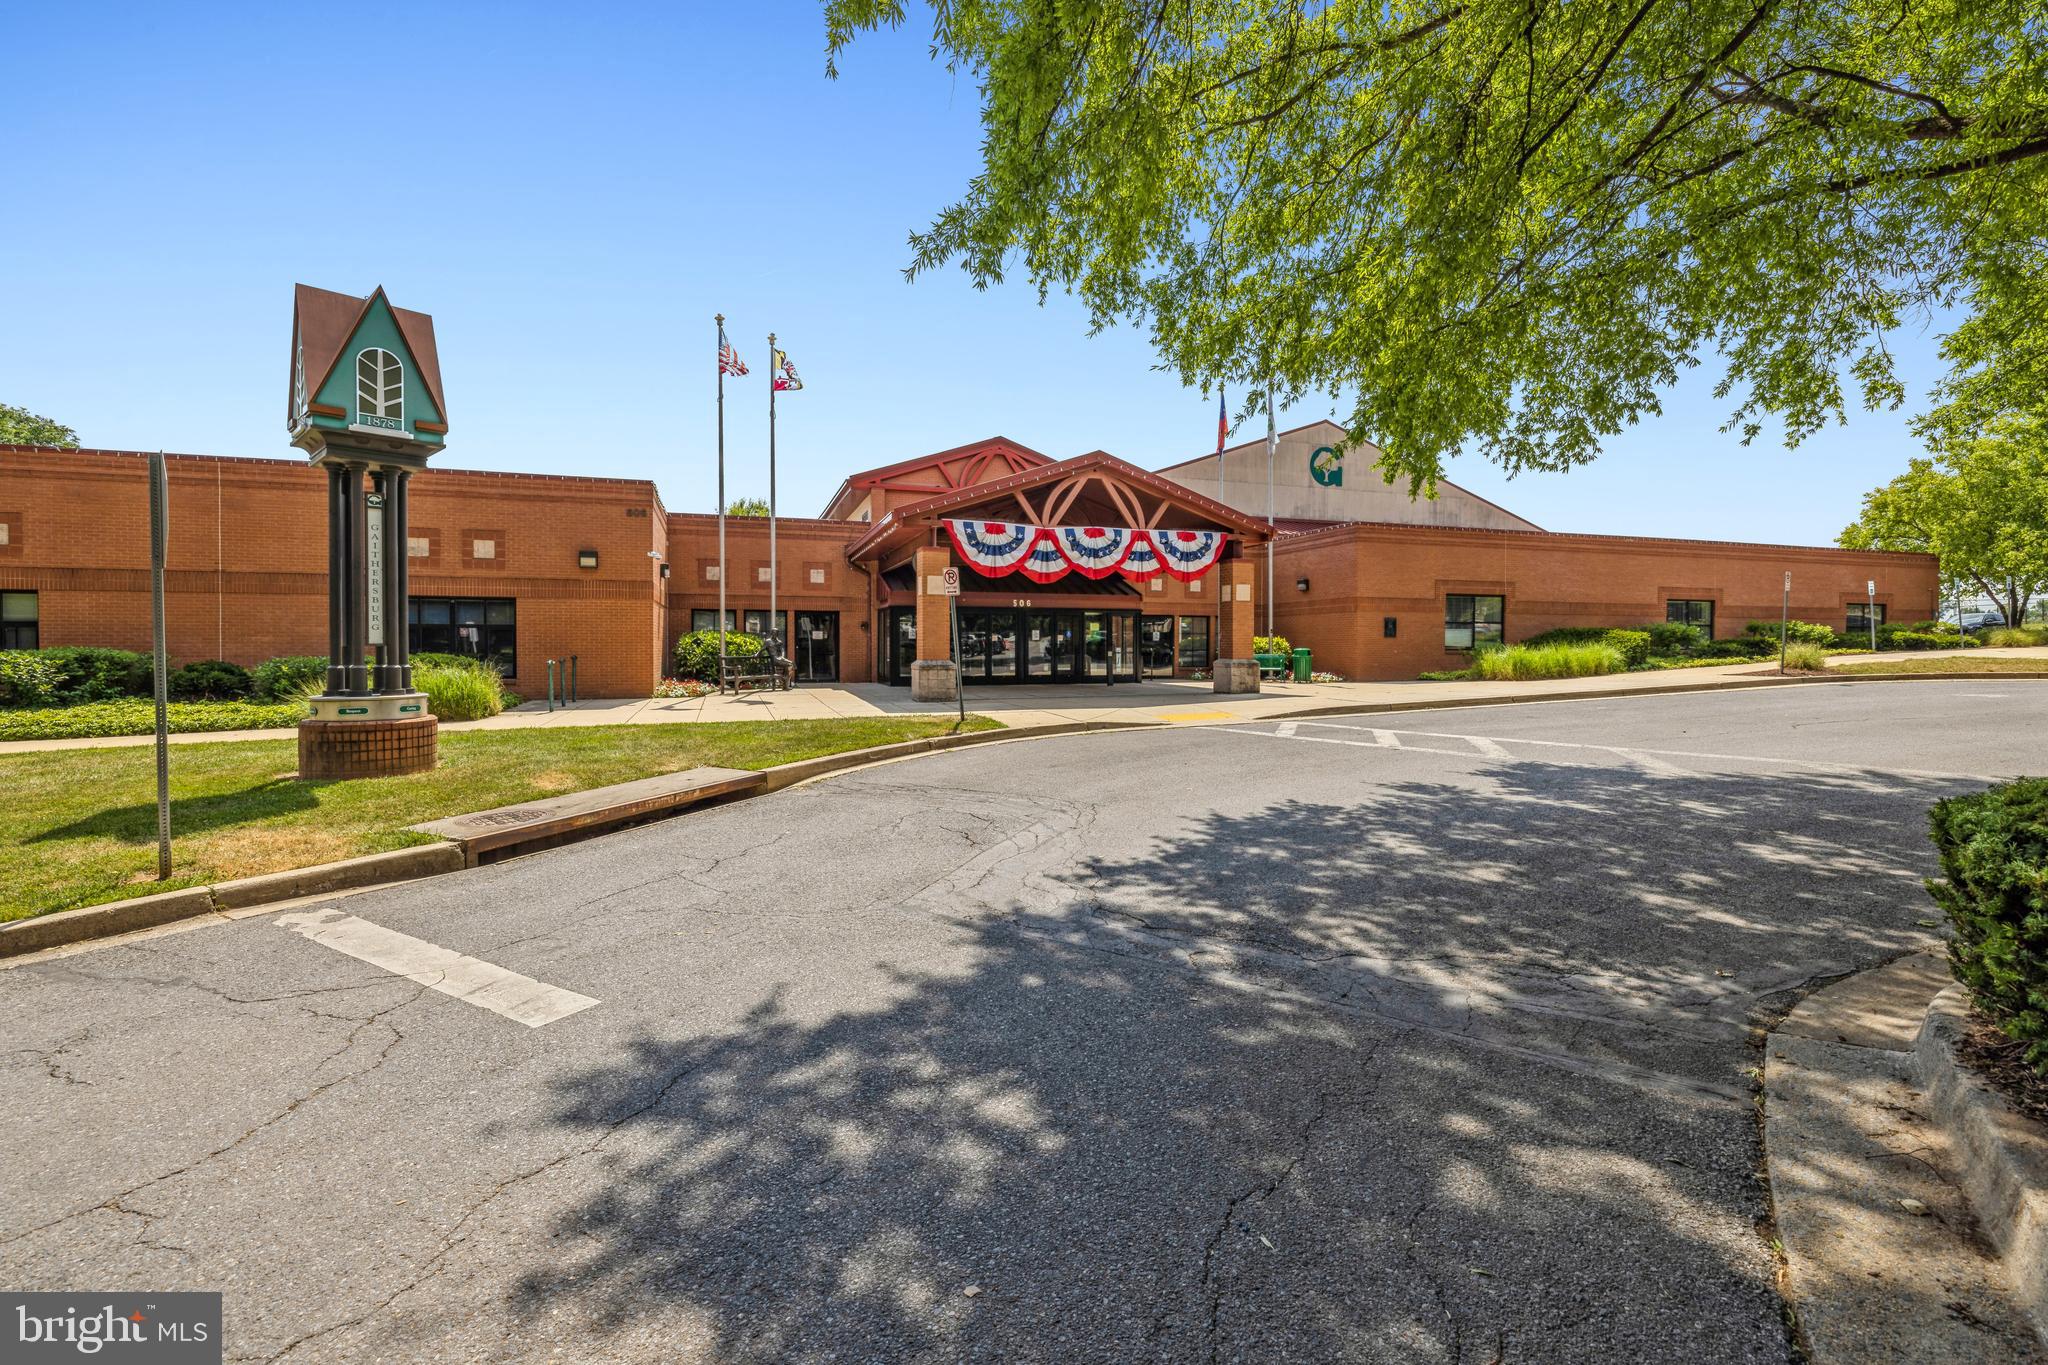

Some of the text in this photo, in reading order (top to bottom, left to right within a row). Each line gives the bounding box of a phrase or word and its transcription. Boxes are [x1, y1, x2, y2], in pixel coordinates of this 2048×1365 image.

[366, 416, 395, 429] 1878
[370, 523, 380, 631] GAITHERSBURG
[1012, 599, 1032, 608] 506
